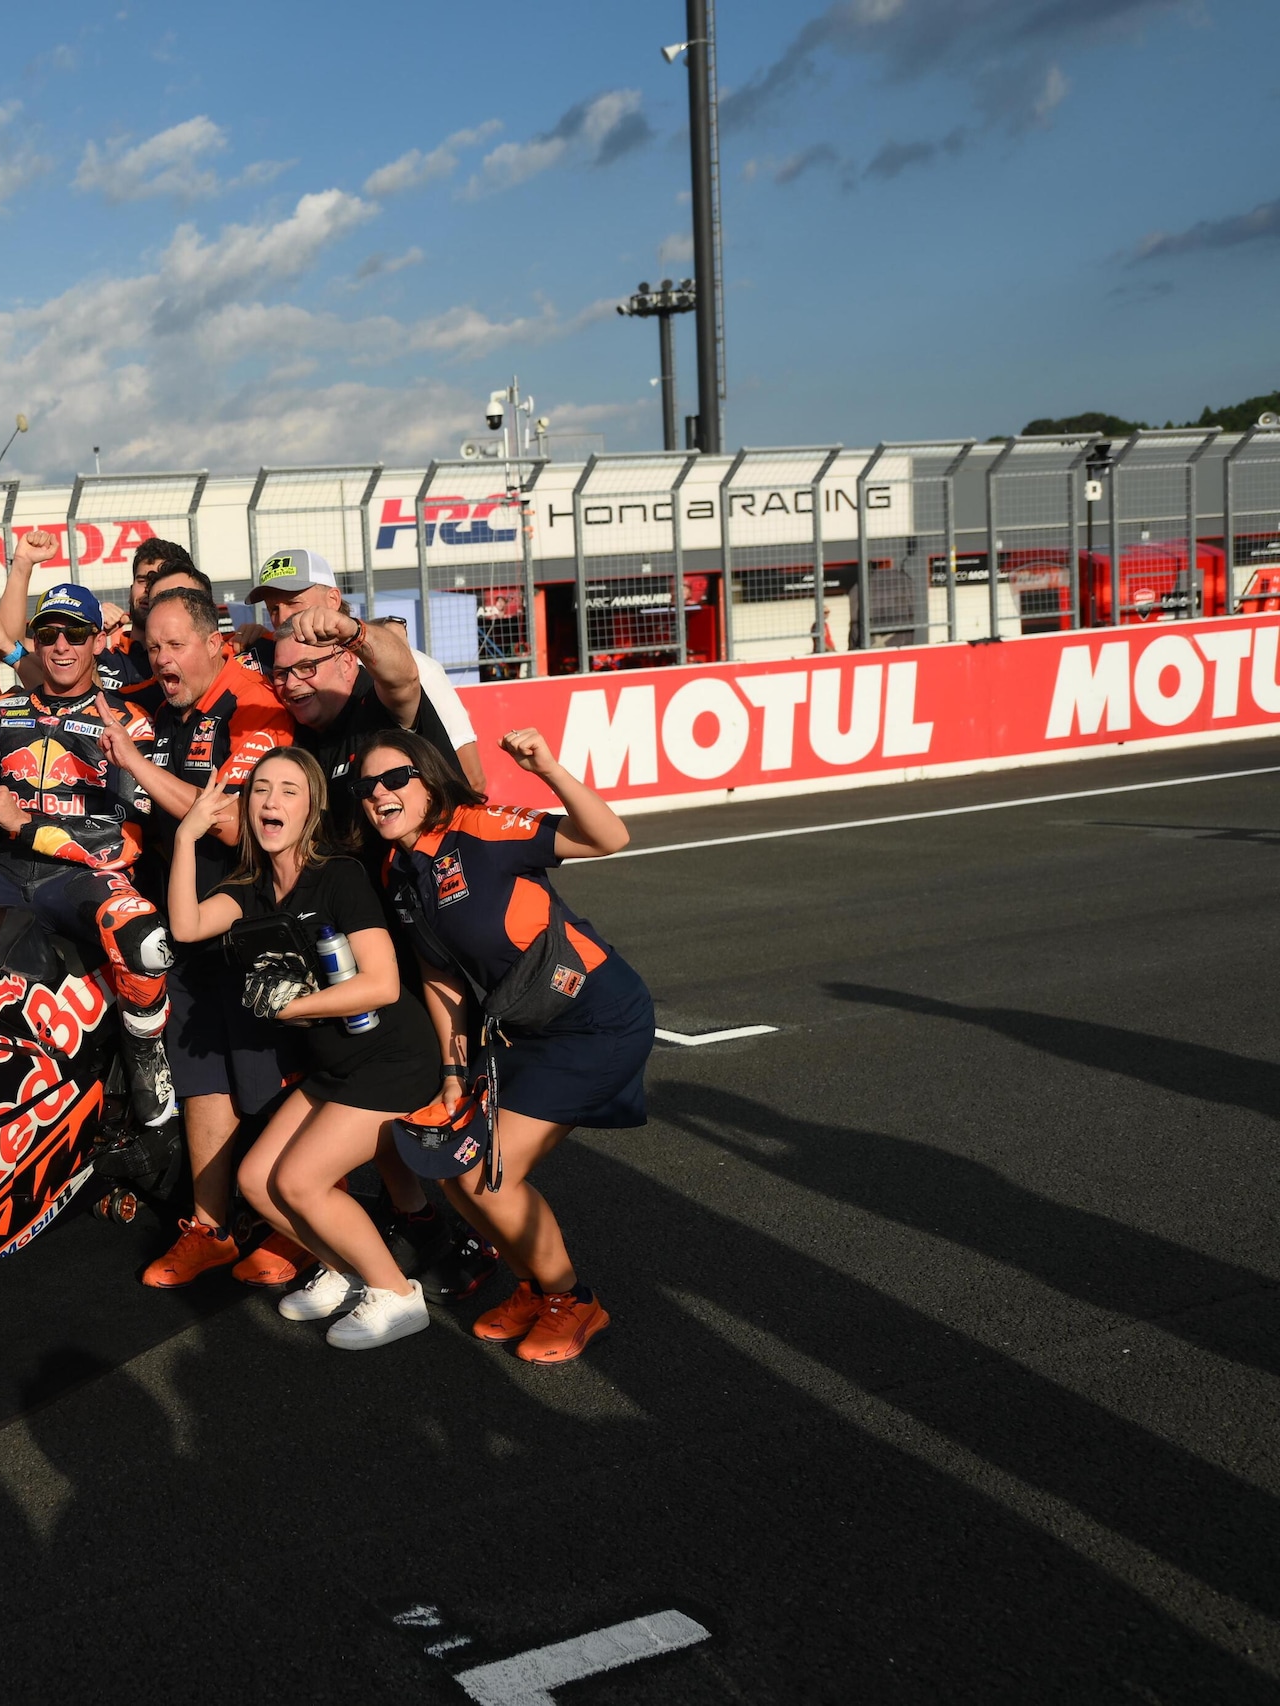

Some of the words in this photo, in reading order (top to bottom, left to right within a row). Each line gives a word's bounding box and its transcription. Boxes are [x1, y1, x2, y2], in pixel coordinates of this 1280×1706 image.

[376, 492, 521, 550] HRC
[729, 486, 891, 518] RACING
[65, 721, 92, 734] Mobil
[556, 661, 935, 790] MOTUL
[43, 793, 86, 816] Bull
[22, 974, 117, 1059] Bu
[0, 1206, 54, 1260] Mobil
